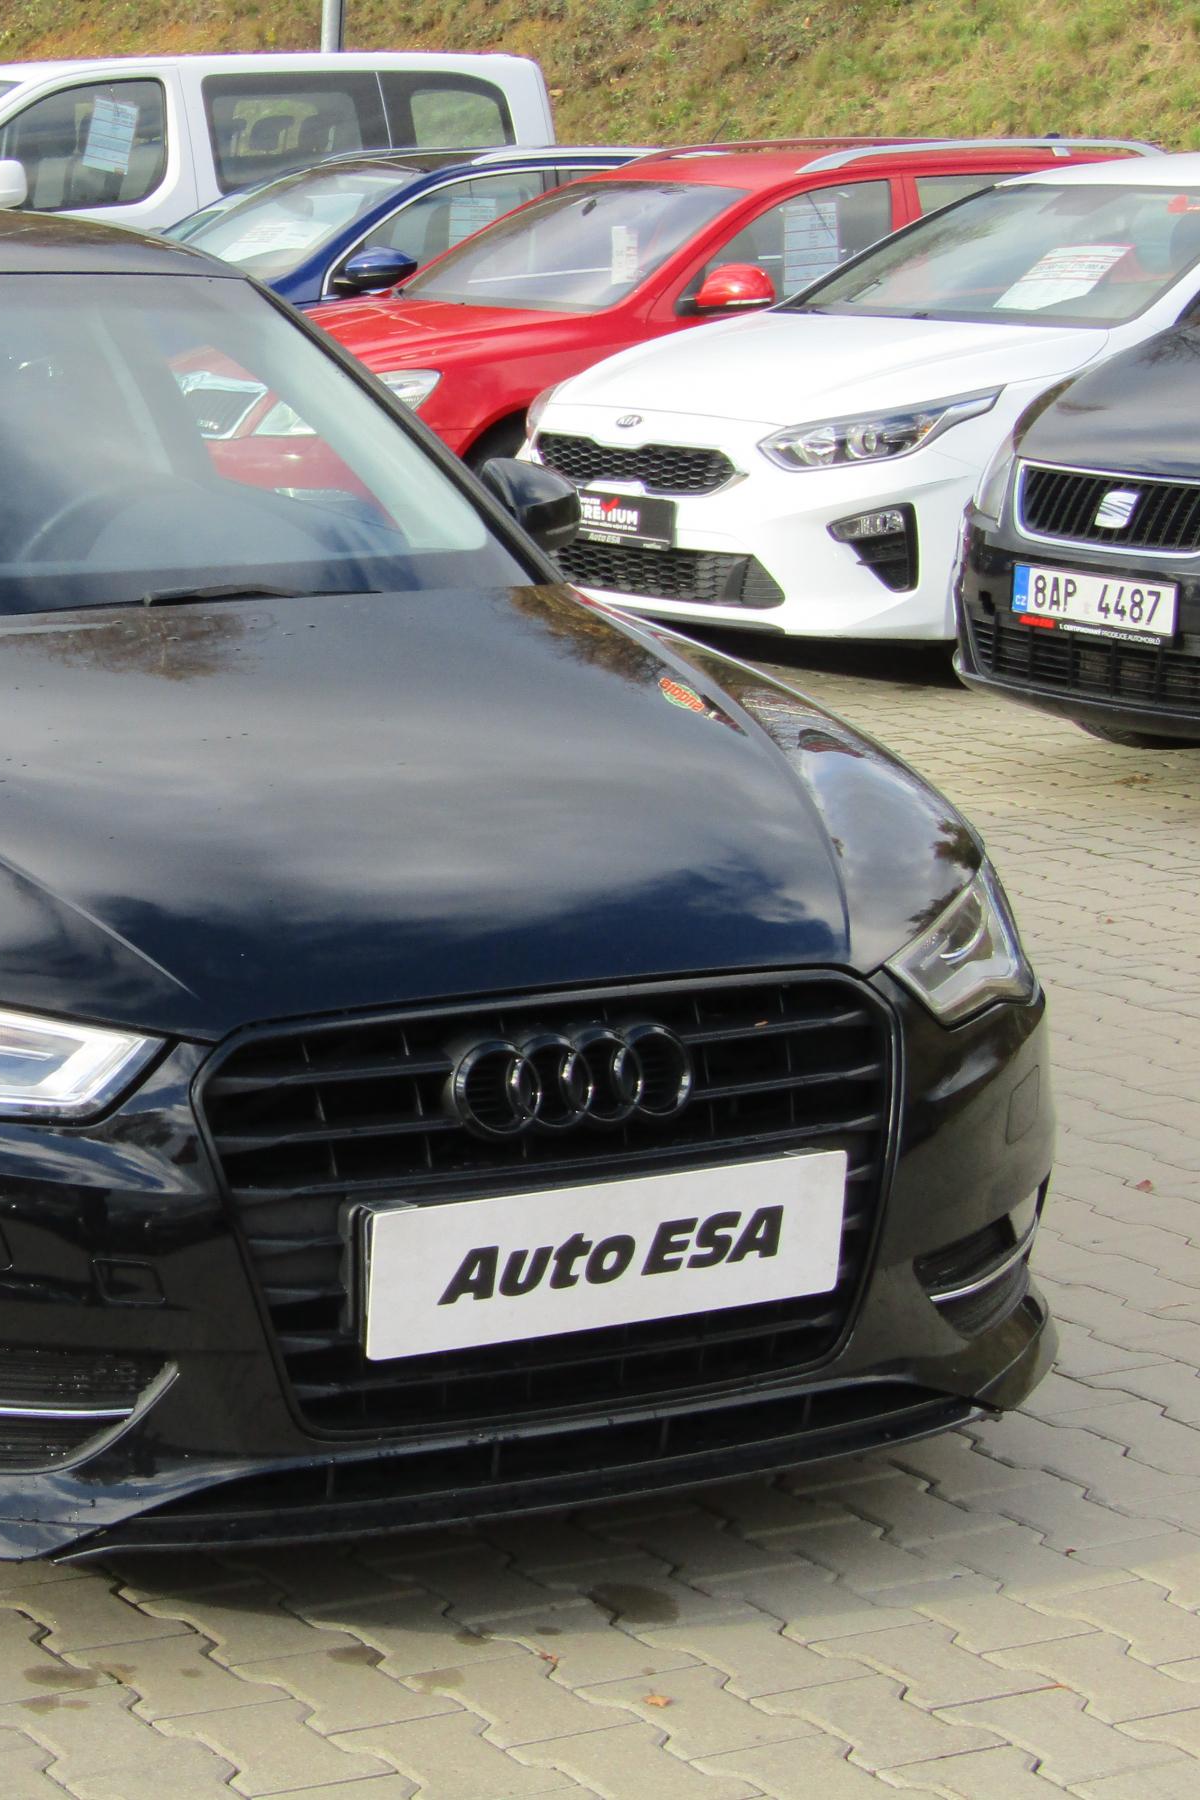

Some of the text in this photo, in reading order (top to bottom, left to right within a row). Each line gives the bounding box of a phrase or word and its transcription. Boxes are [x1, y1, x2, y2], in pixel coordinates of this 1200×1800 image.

[1015, 574, 1162, 626] CZ 8AP 4487
[437, 1204, 785, 1306] Auto ESA
